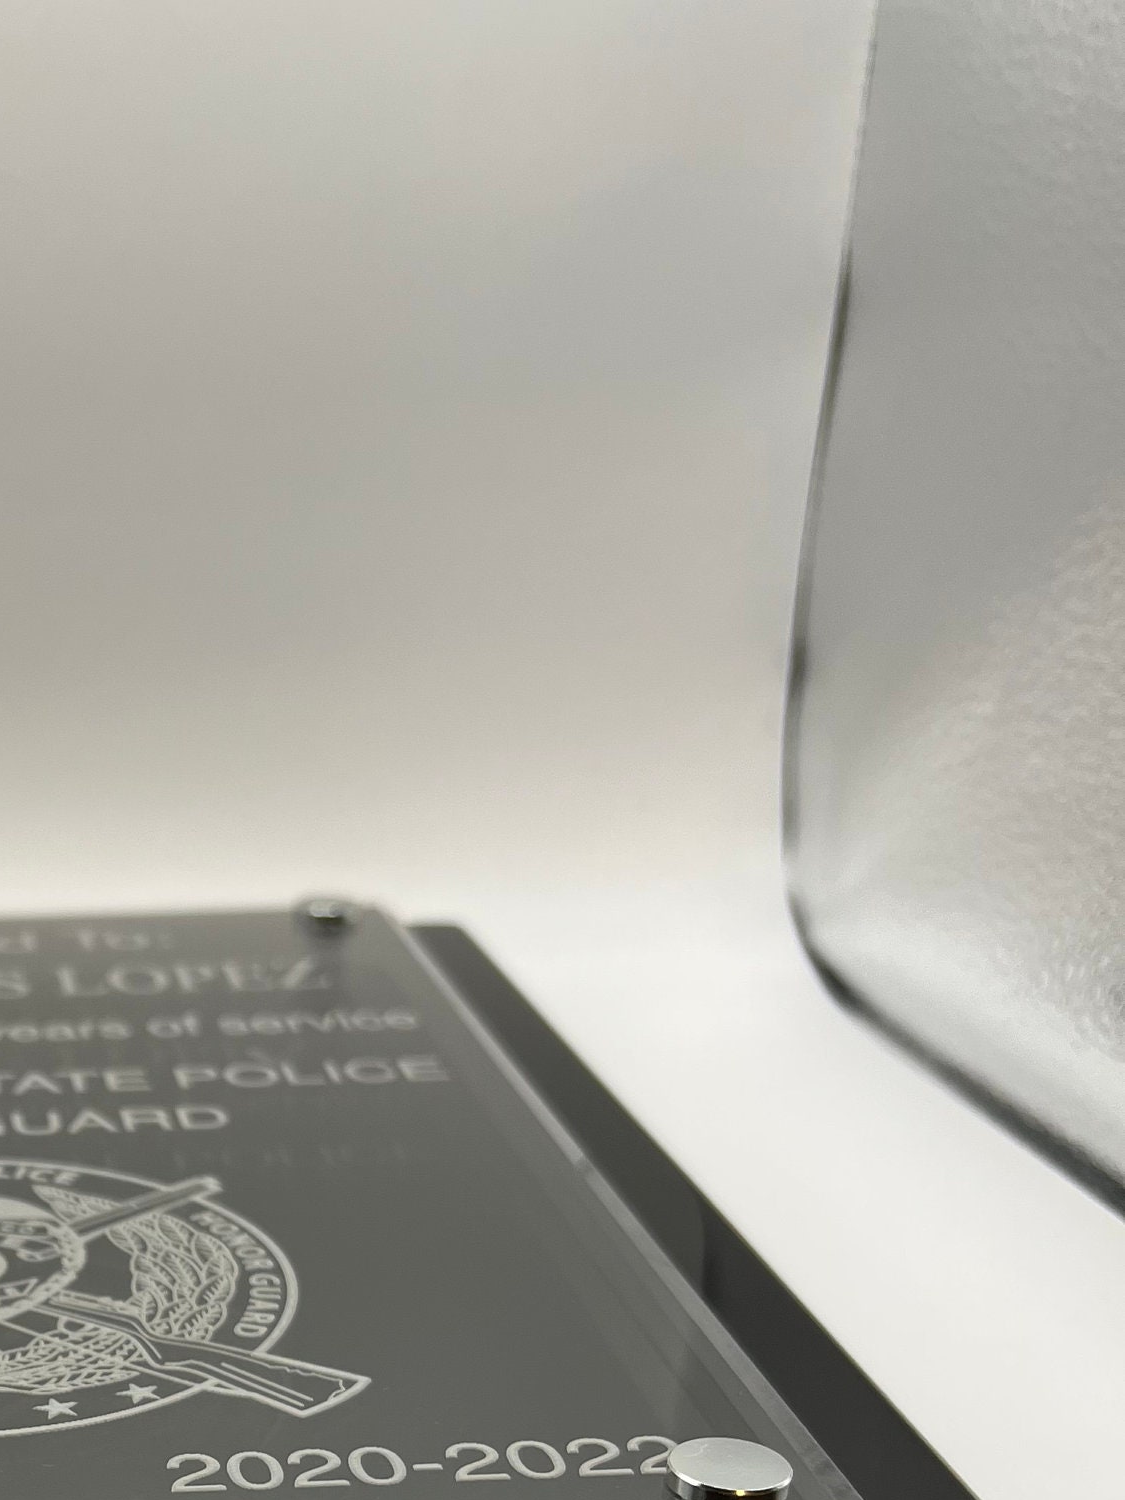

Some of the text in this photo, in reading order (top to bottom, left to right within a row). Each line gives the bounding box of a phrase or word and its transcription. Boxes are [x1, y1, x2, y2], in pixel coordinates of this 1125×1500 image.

[56, 956, 334, 998] LOPEZ
[147, 1013, 200, 1038] of
[218, 1009, 418, 1036] service
[174, 1057, 451, 1091] POLICE
[189, 1210, 281, 1339] HONOR GUARD
[166, 1434, 678, 1494] 2020-2022
